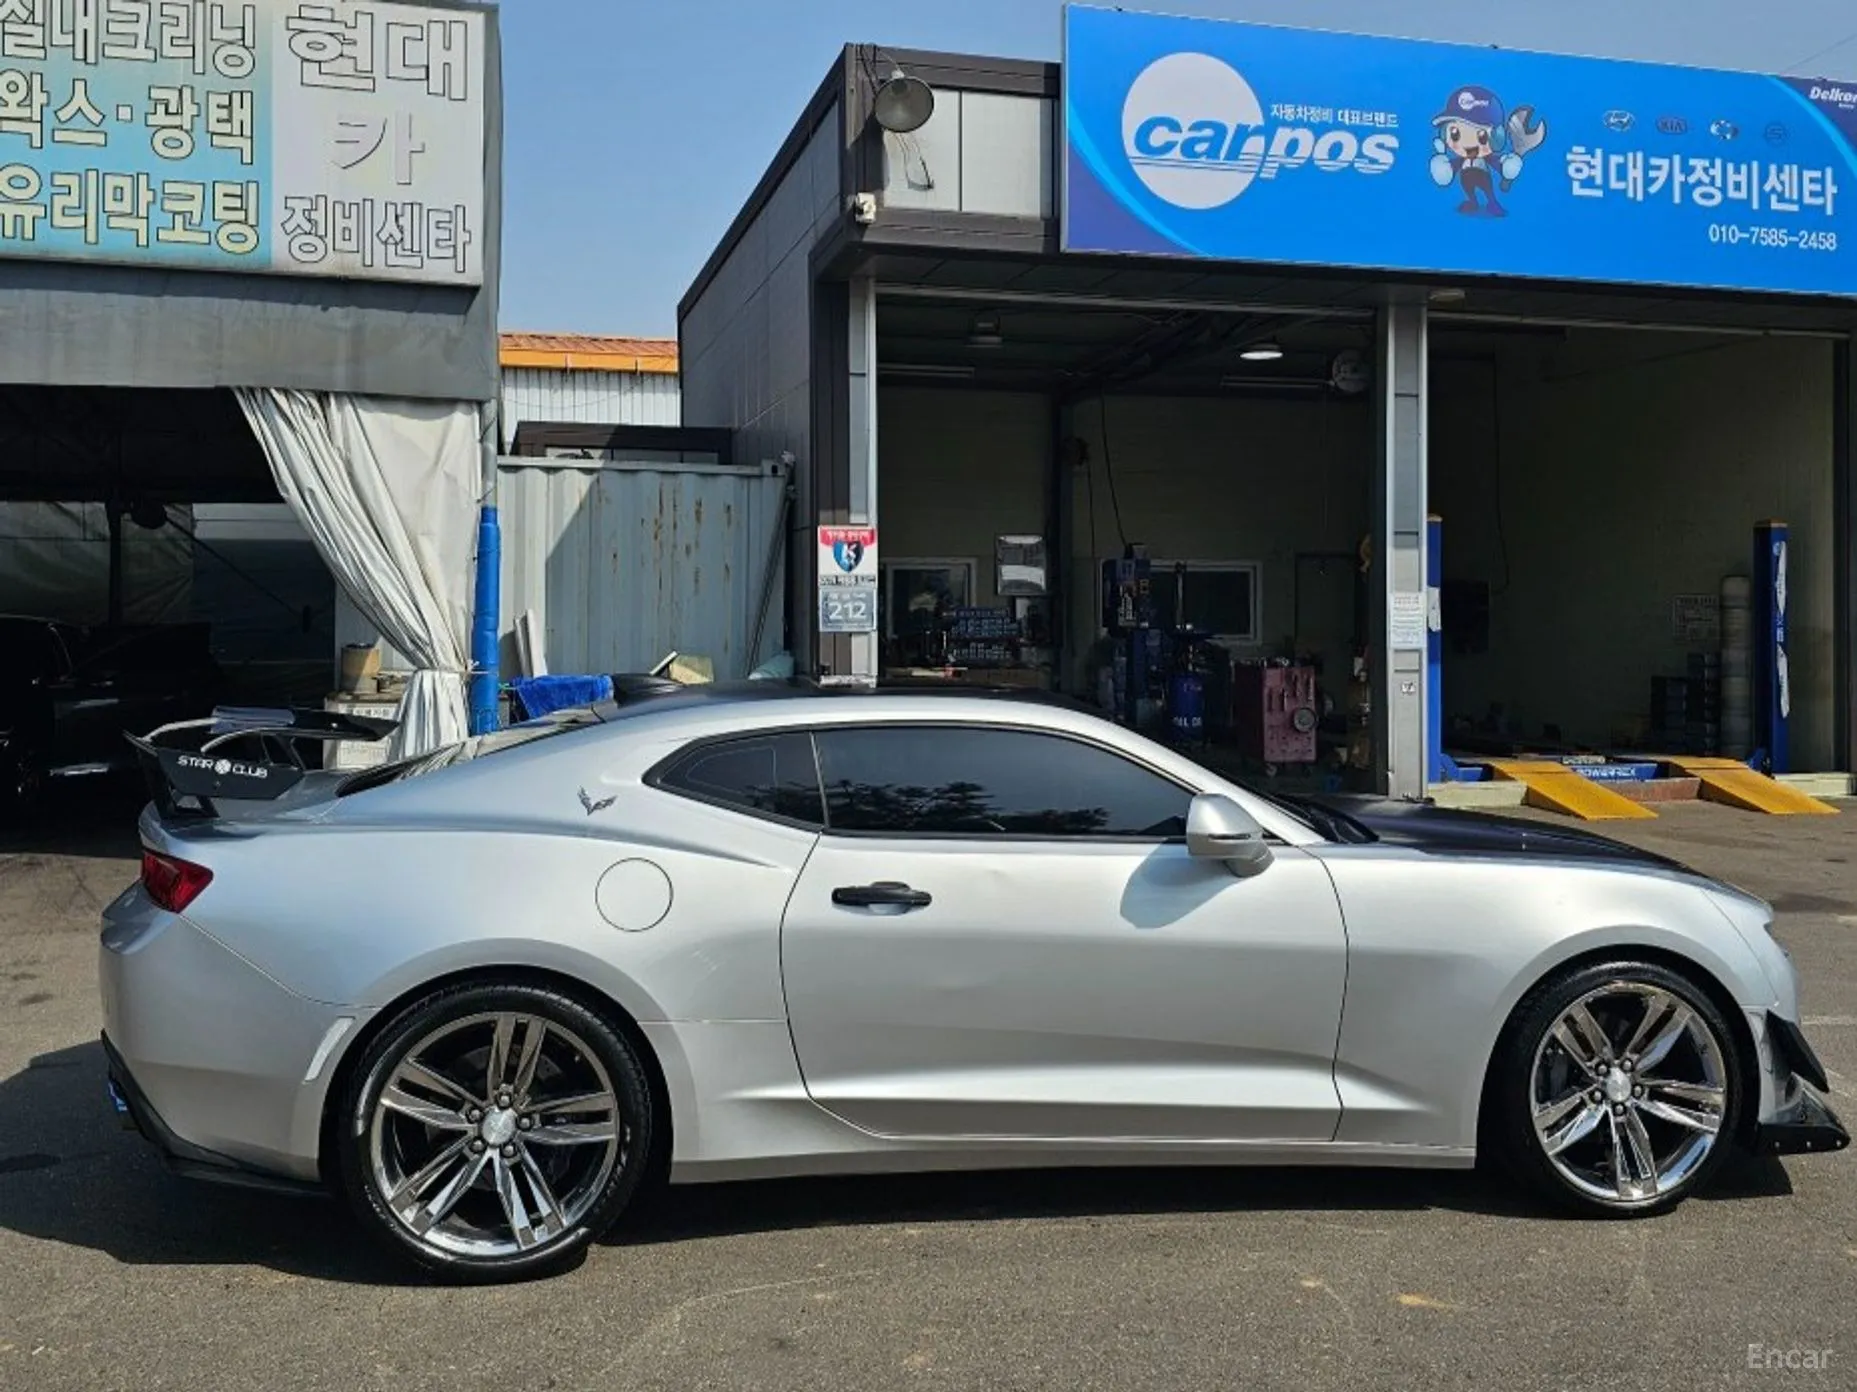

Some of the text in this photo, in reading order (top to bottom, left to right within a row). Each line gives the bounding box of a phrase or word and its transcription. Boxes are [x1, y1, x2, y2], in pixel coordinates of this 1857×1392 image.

[285, 5, 467, 100] 현대
[1134, 115, 1400, 179] carpos
[1270, 103, 1399, 128] 자동차정비 대표브랜드
[0, 163, 259, 254] 유리막코팅
[1567, 146, 1838, 216] 현대카정비센타
[280, 195, 472, 273] 정비센타
[1708, 223, 1838, 251] 010-7585-2458
[828, 600, 867, 620] 212
[177, 755, 268, 779] STAR CLUB
